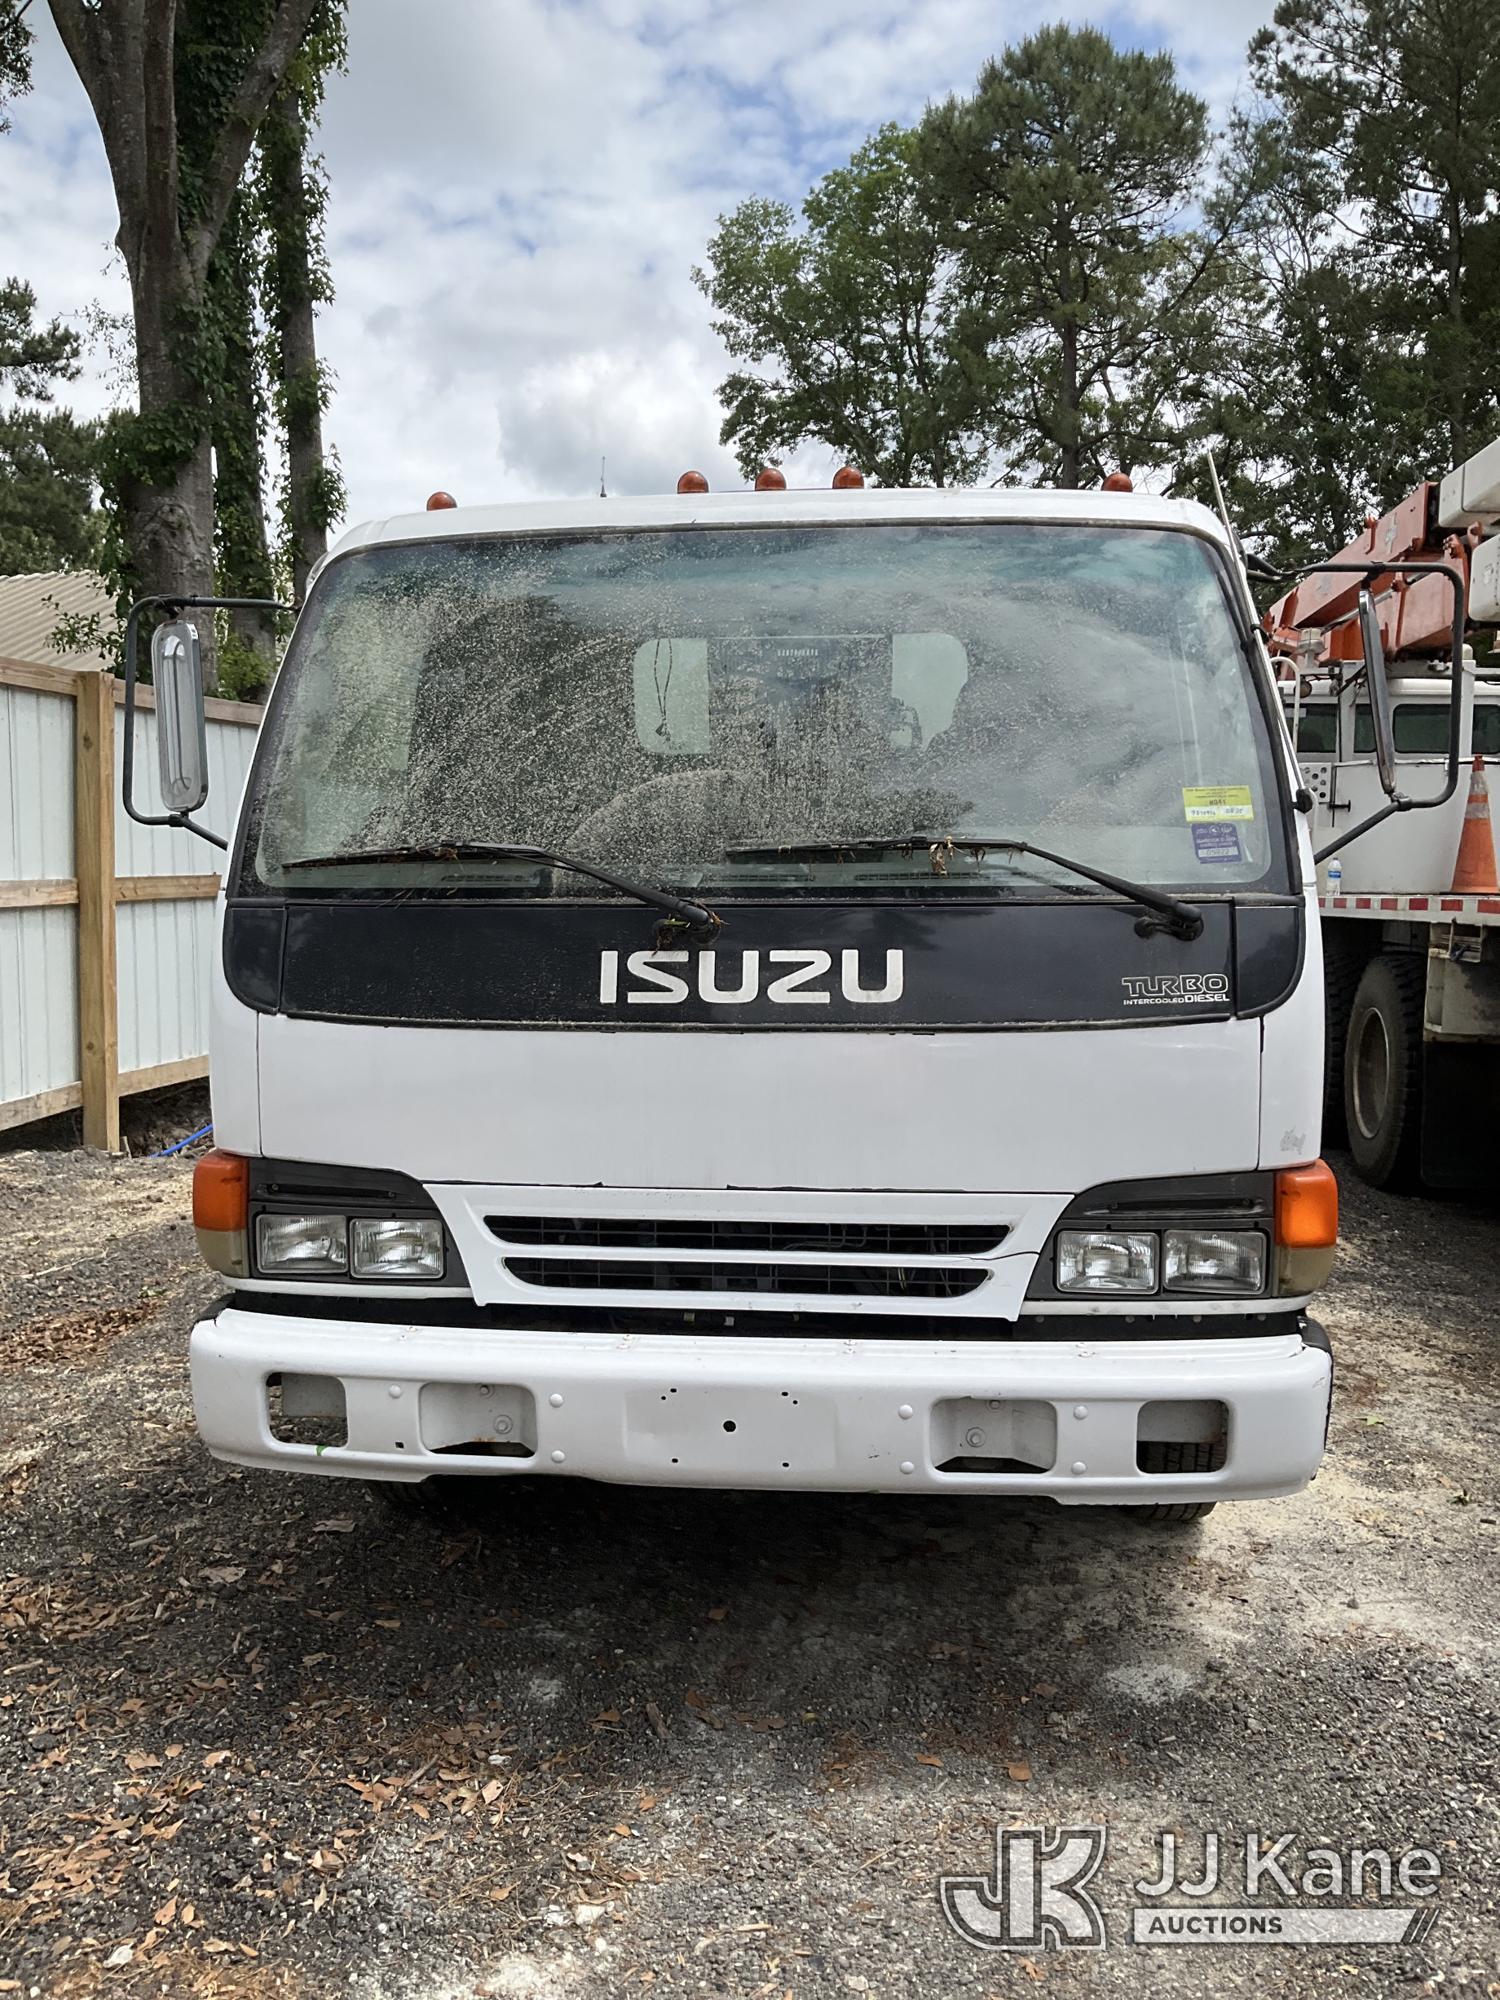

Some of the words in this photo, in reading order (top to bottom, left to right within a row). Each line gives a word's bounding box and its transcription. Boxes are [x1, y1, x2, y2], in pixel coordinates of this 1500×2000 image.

[600, 949, 904, 1003] ISUZU
[1121, 974, 1229, 997] TURBO
[1184, 993, 1230, 1002] DIESEL
